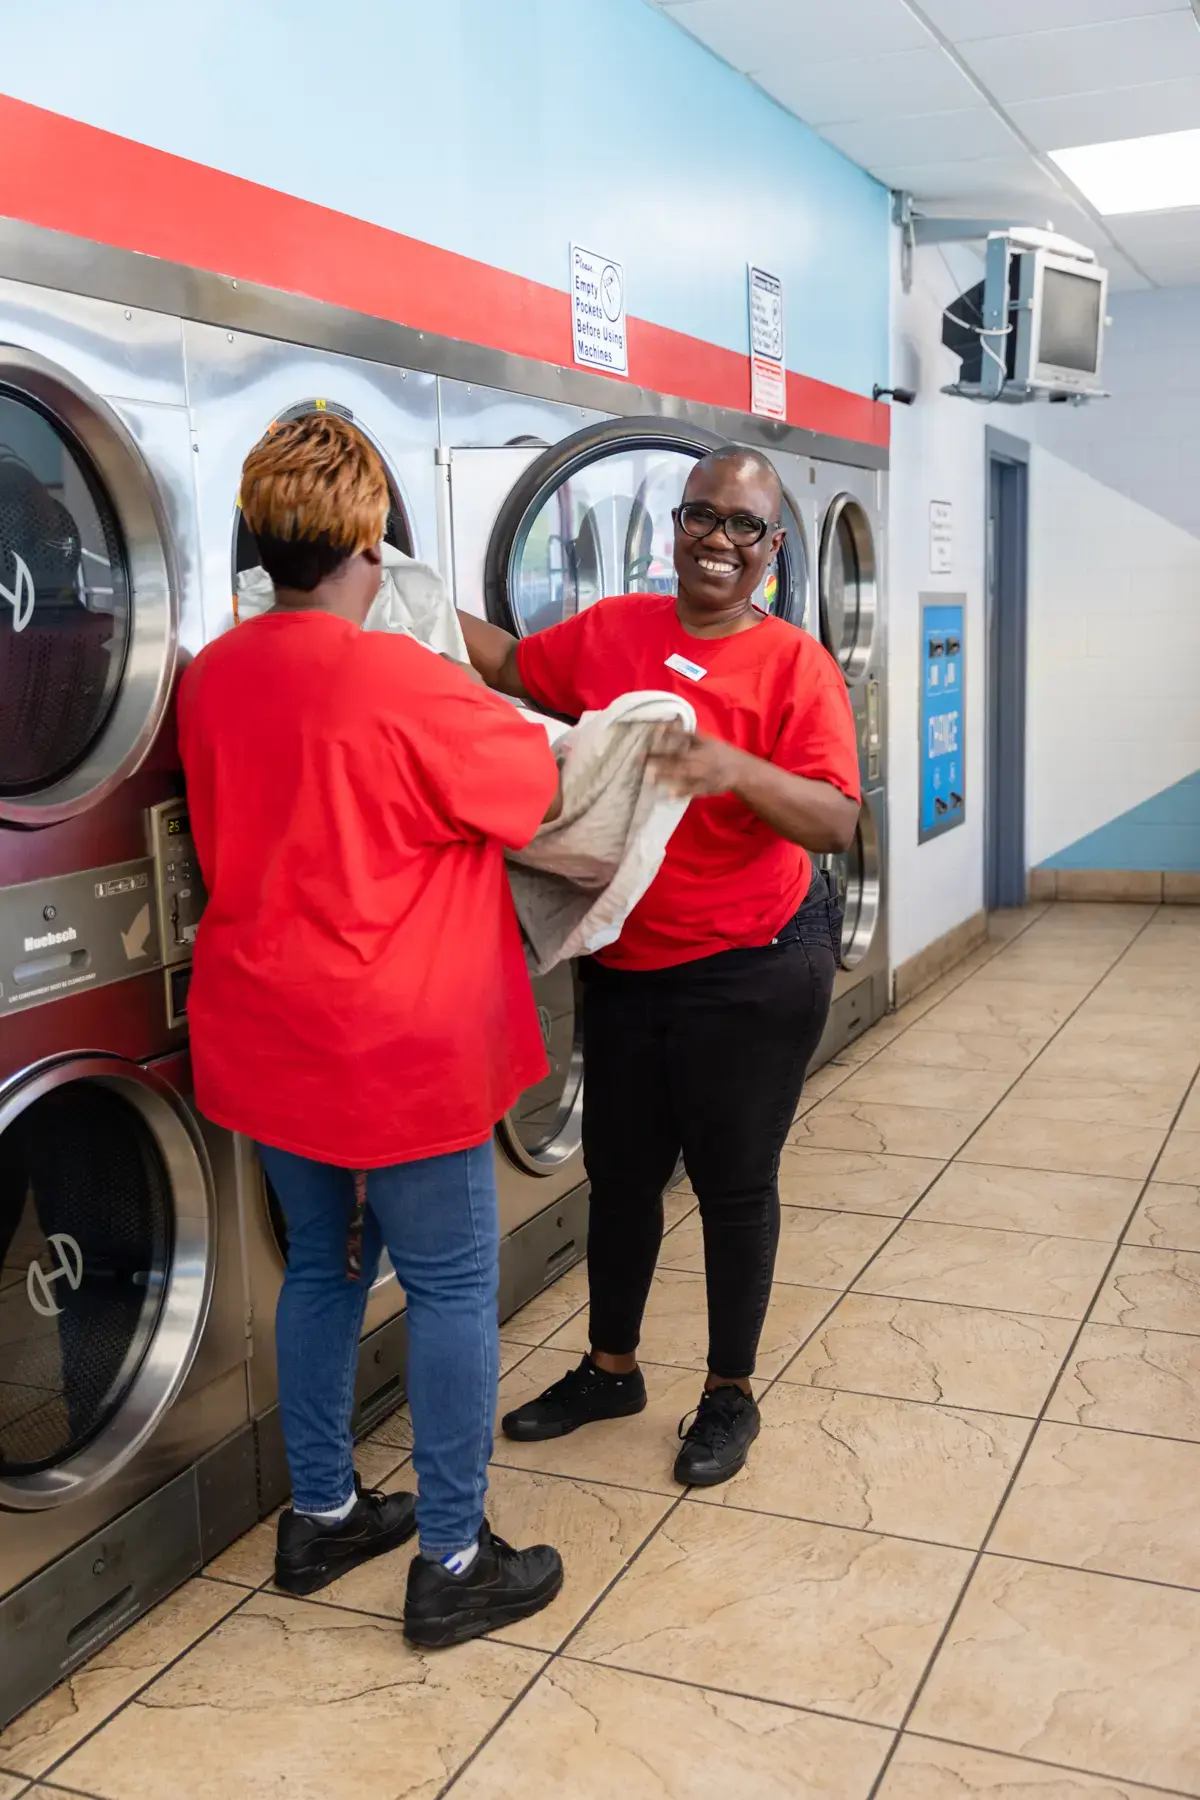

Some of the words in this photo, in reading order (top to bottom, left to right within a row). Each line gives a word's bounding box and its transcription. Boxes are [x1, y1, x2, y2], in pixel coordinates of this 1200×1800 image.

[575, 274, 599, 300] Empty
[576, 296, 603, 319] Pockets
[577, 318, 601, 339] Before
[602, 326, 623, 349] Using
[577, 339, 613, 363] Machines
[24, 926, 77, 952] Huebsch
